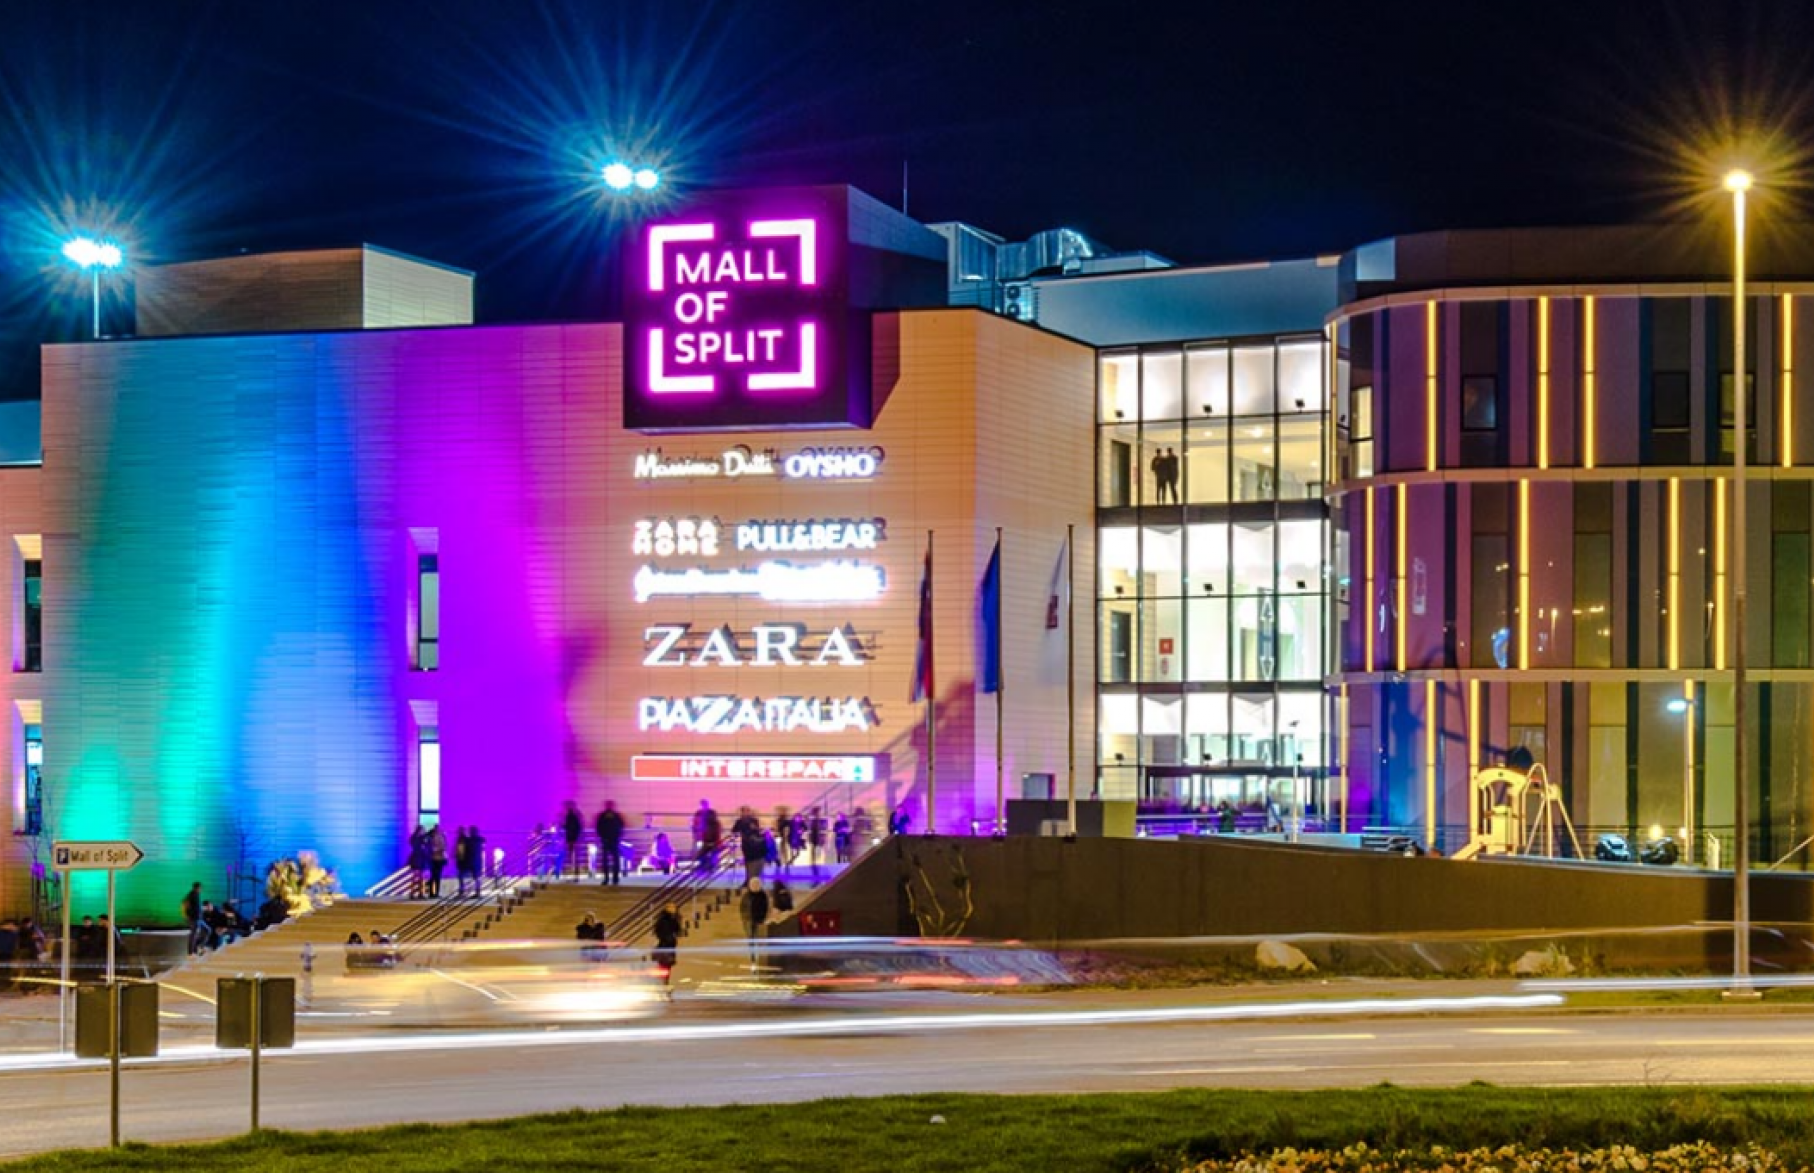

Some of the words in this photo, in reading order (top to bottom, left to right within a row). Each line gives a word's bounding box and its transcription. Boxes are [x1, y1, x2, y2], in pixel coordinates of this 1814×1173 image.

[675, 249, 787, 284] MALL
[674, 291, 728, 323] OF
[675, 329, 783, 364] SPLIT
[785, 454, 876, 478] OYSHO
[737, 523, 877, 551] PULL&BEAR
[642, 626, 865, 667] ZARA
[639, 697, 762, 733] PIAZZA
[764, 697, 869, 733] ITALIA
[680, 760, 843, 778] INTERSPAR
[93, 850, 104, 861] of
[107, 849, 129, 864] Split
